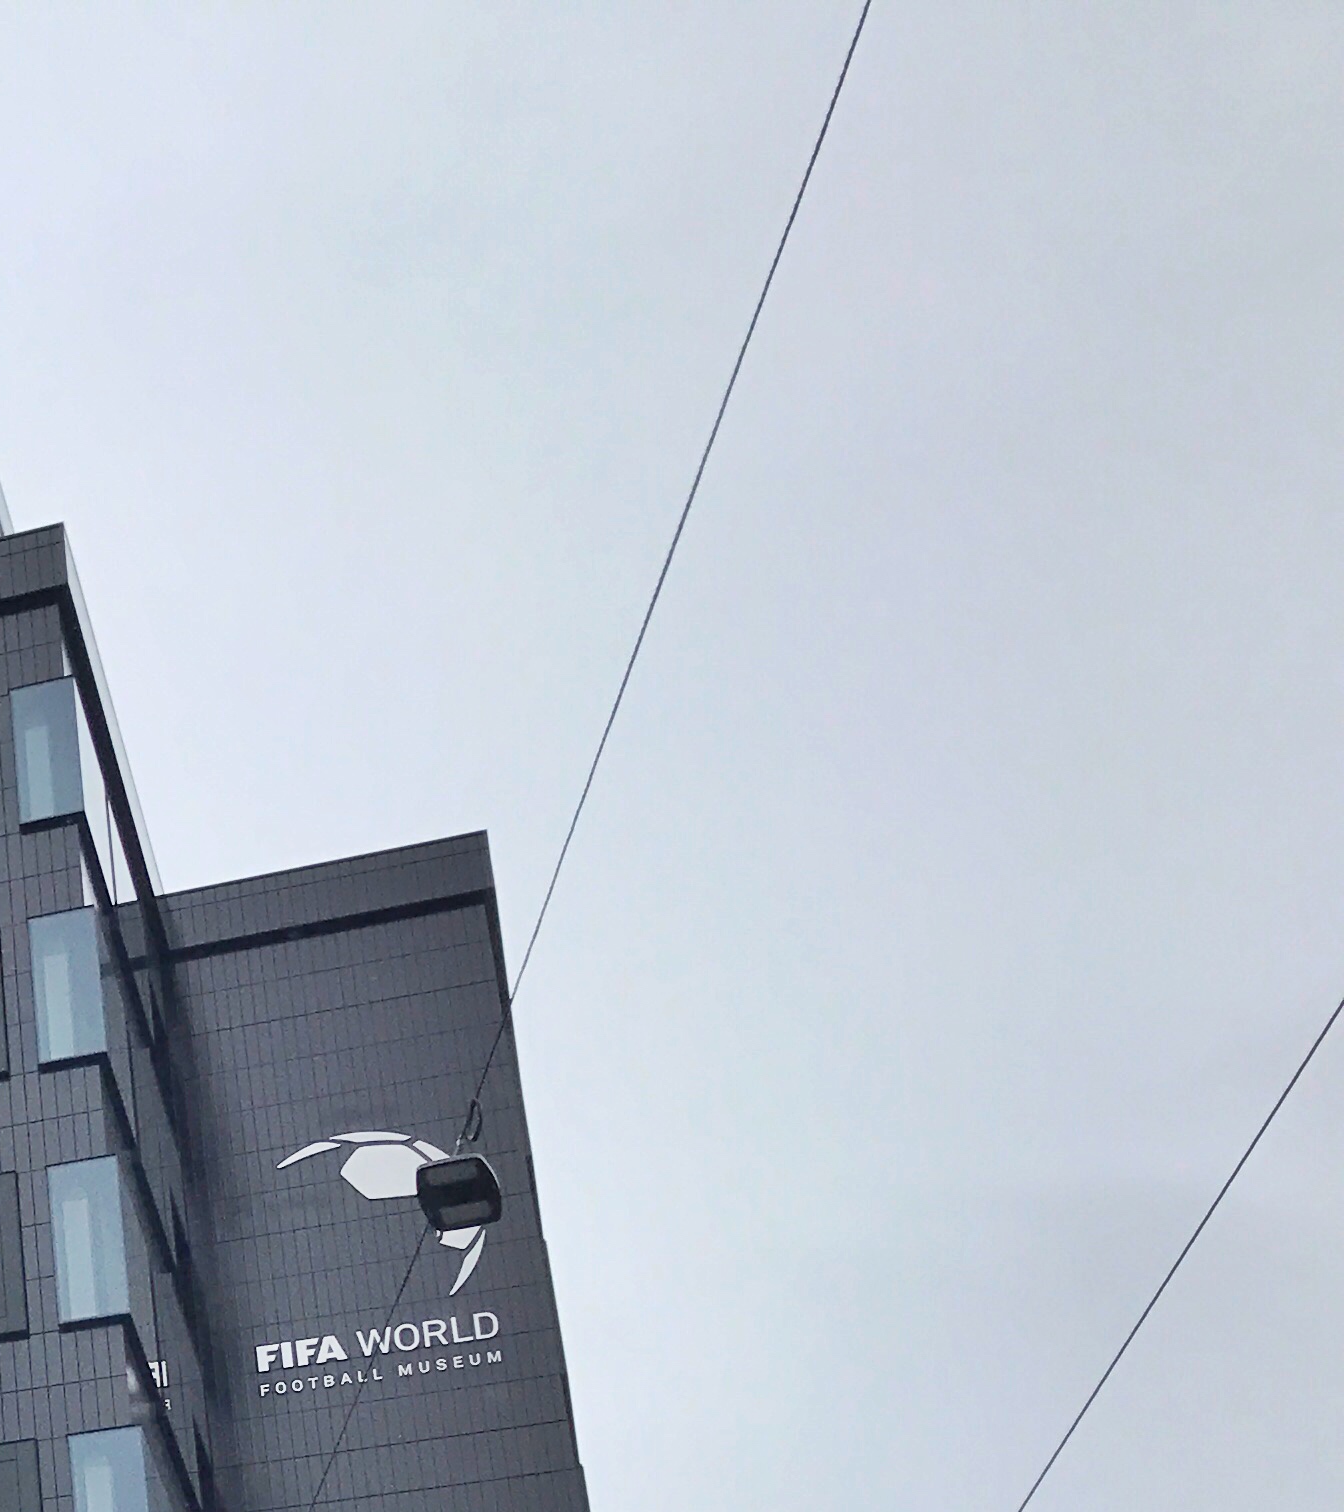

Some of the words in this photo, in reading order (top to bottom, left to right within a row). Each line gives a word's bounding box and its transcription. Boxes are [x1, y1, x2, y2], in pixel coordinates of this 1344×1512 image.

[255, 1335, 348, 1373] FIFA
[355, 1311, 500, 1357] WORLD
[260, 1369, 384, 1397] FOOTBALL
[398, 1350, 503, 1377] MUSEUM
